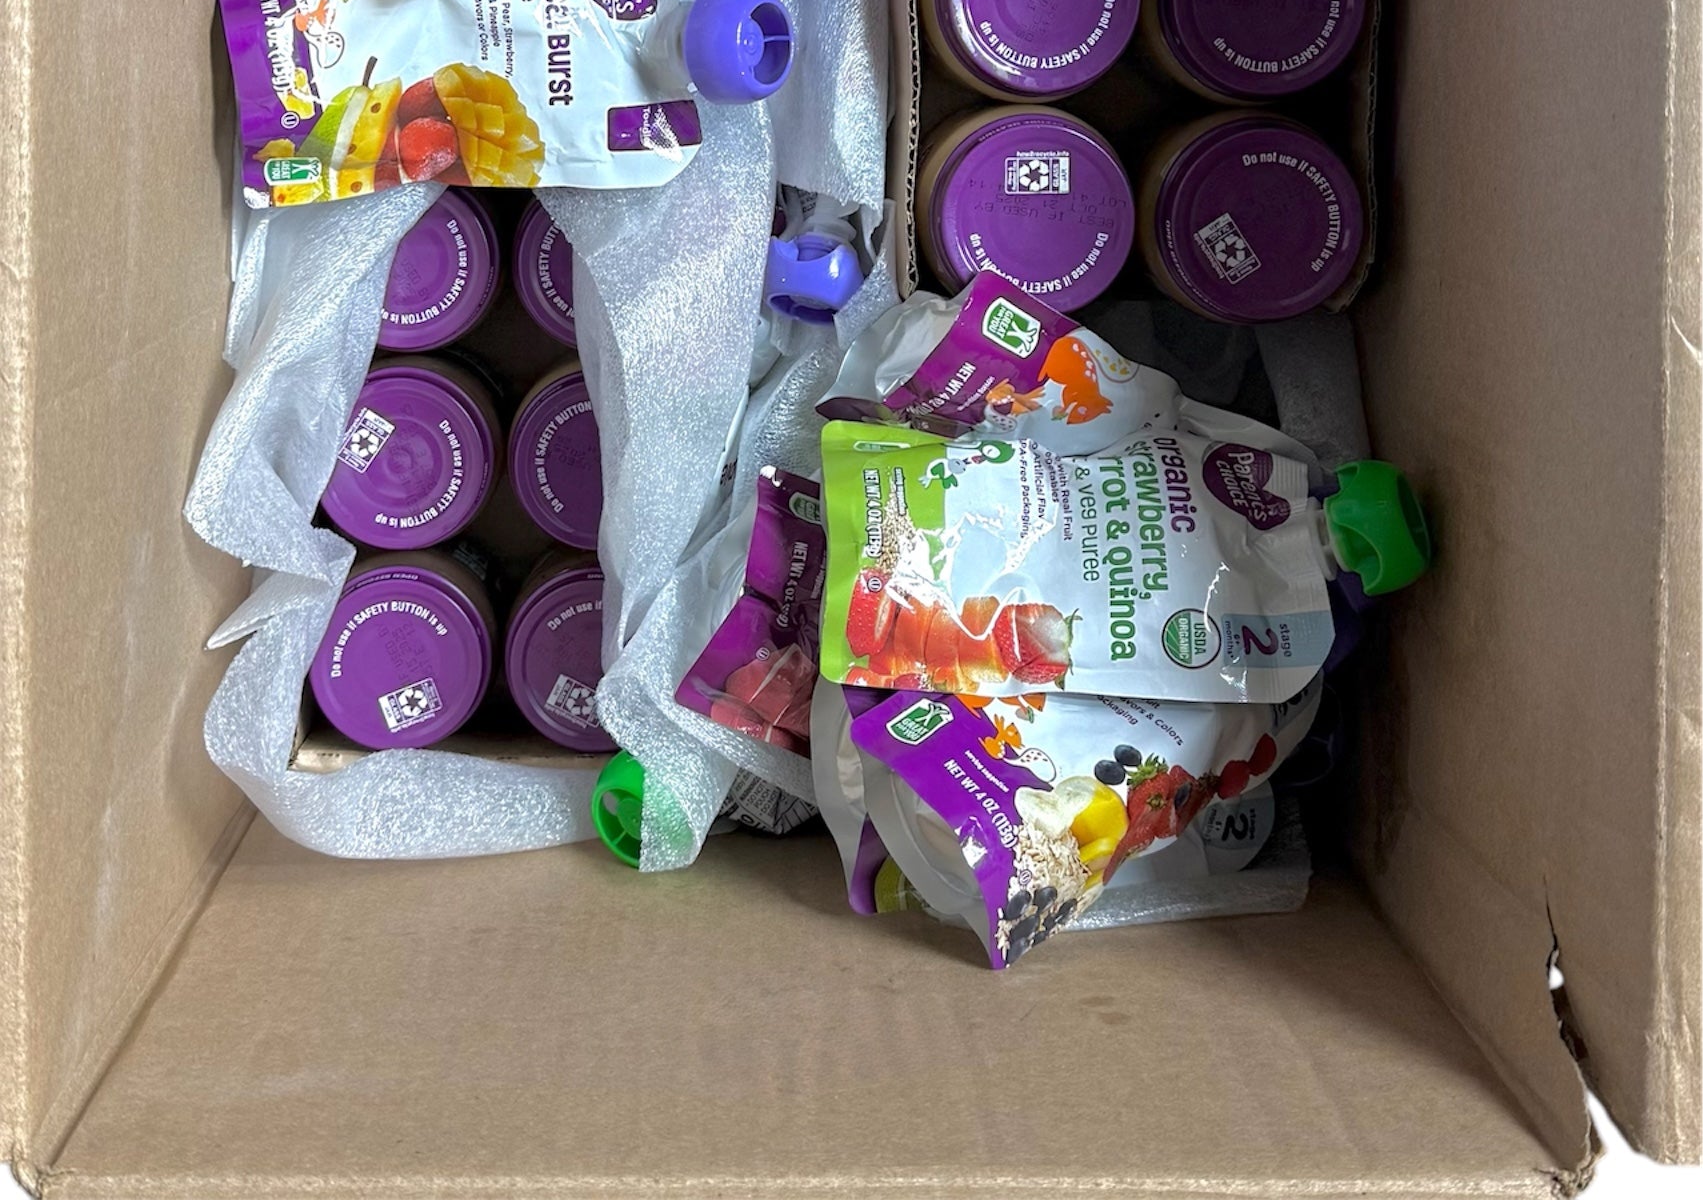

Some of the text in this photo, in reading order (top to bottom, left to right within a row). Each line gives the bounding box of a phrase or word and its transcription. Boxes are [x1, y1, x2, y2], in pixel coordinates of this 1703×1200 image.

[479, 32, 490, 61] Colors
[488, 6, 502, 47] Pineapple
[503, 26, 516, 79] Strawberry,
[547, 33, 574, 106] Burst
[1242, 152, 1341, 272] Do not use if SAFETY BUTTON is up
[997, 310, 1014, 338] GREAT
[944, 378, 964, 396] WT
[956, 361, 977, 382] NET
[374, 419, 463, 528] Do not use if SAFETY BUTTON is up
[863, 468, 880, 485] NET
[865, 484, 882, 497] WT
[1032, 451, 1045, 496] Artificial
[1152, 437, 1197, 533] organic
[1215, 460, 1245, 508] CHOICE
[1228, 451, 1270, 522] Parent's
[866, 508, 883, 524] OZ
[1057, 463, 1073, 541] with Real Fruit
[1074, 466, 1101, 582] & veg Puree
[1106, 519, 1130, 541] &
[792, 541, 809, 561] NET
[1102, 545, 1138, 661] quinoa
[330, 601, 448, 678] Do not use if SAFETY BUTTON is up
[1178, 617, 1190, 659] ORGANIC
[1193, 622, 1206, 655] USDA
[1241, 625, 1279, 656] 2
[1279, 623, 1293, 658] stage
[1154, 719, 1184, 746] Colors
[944, 759, 1018, 848] NET WT OZ (113g)
[1221, 813, 1249, 841] 2
